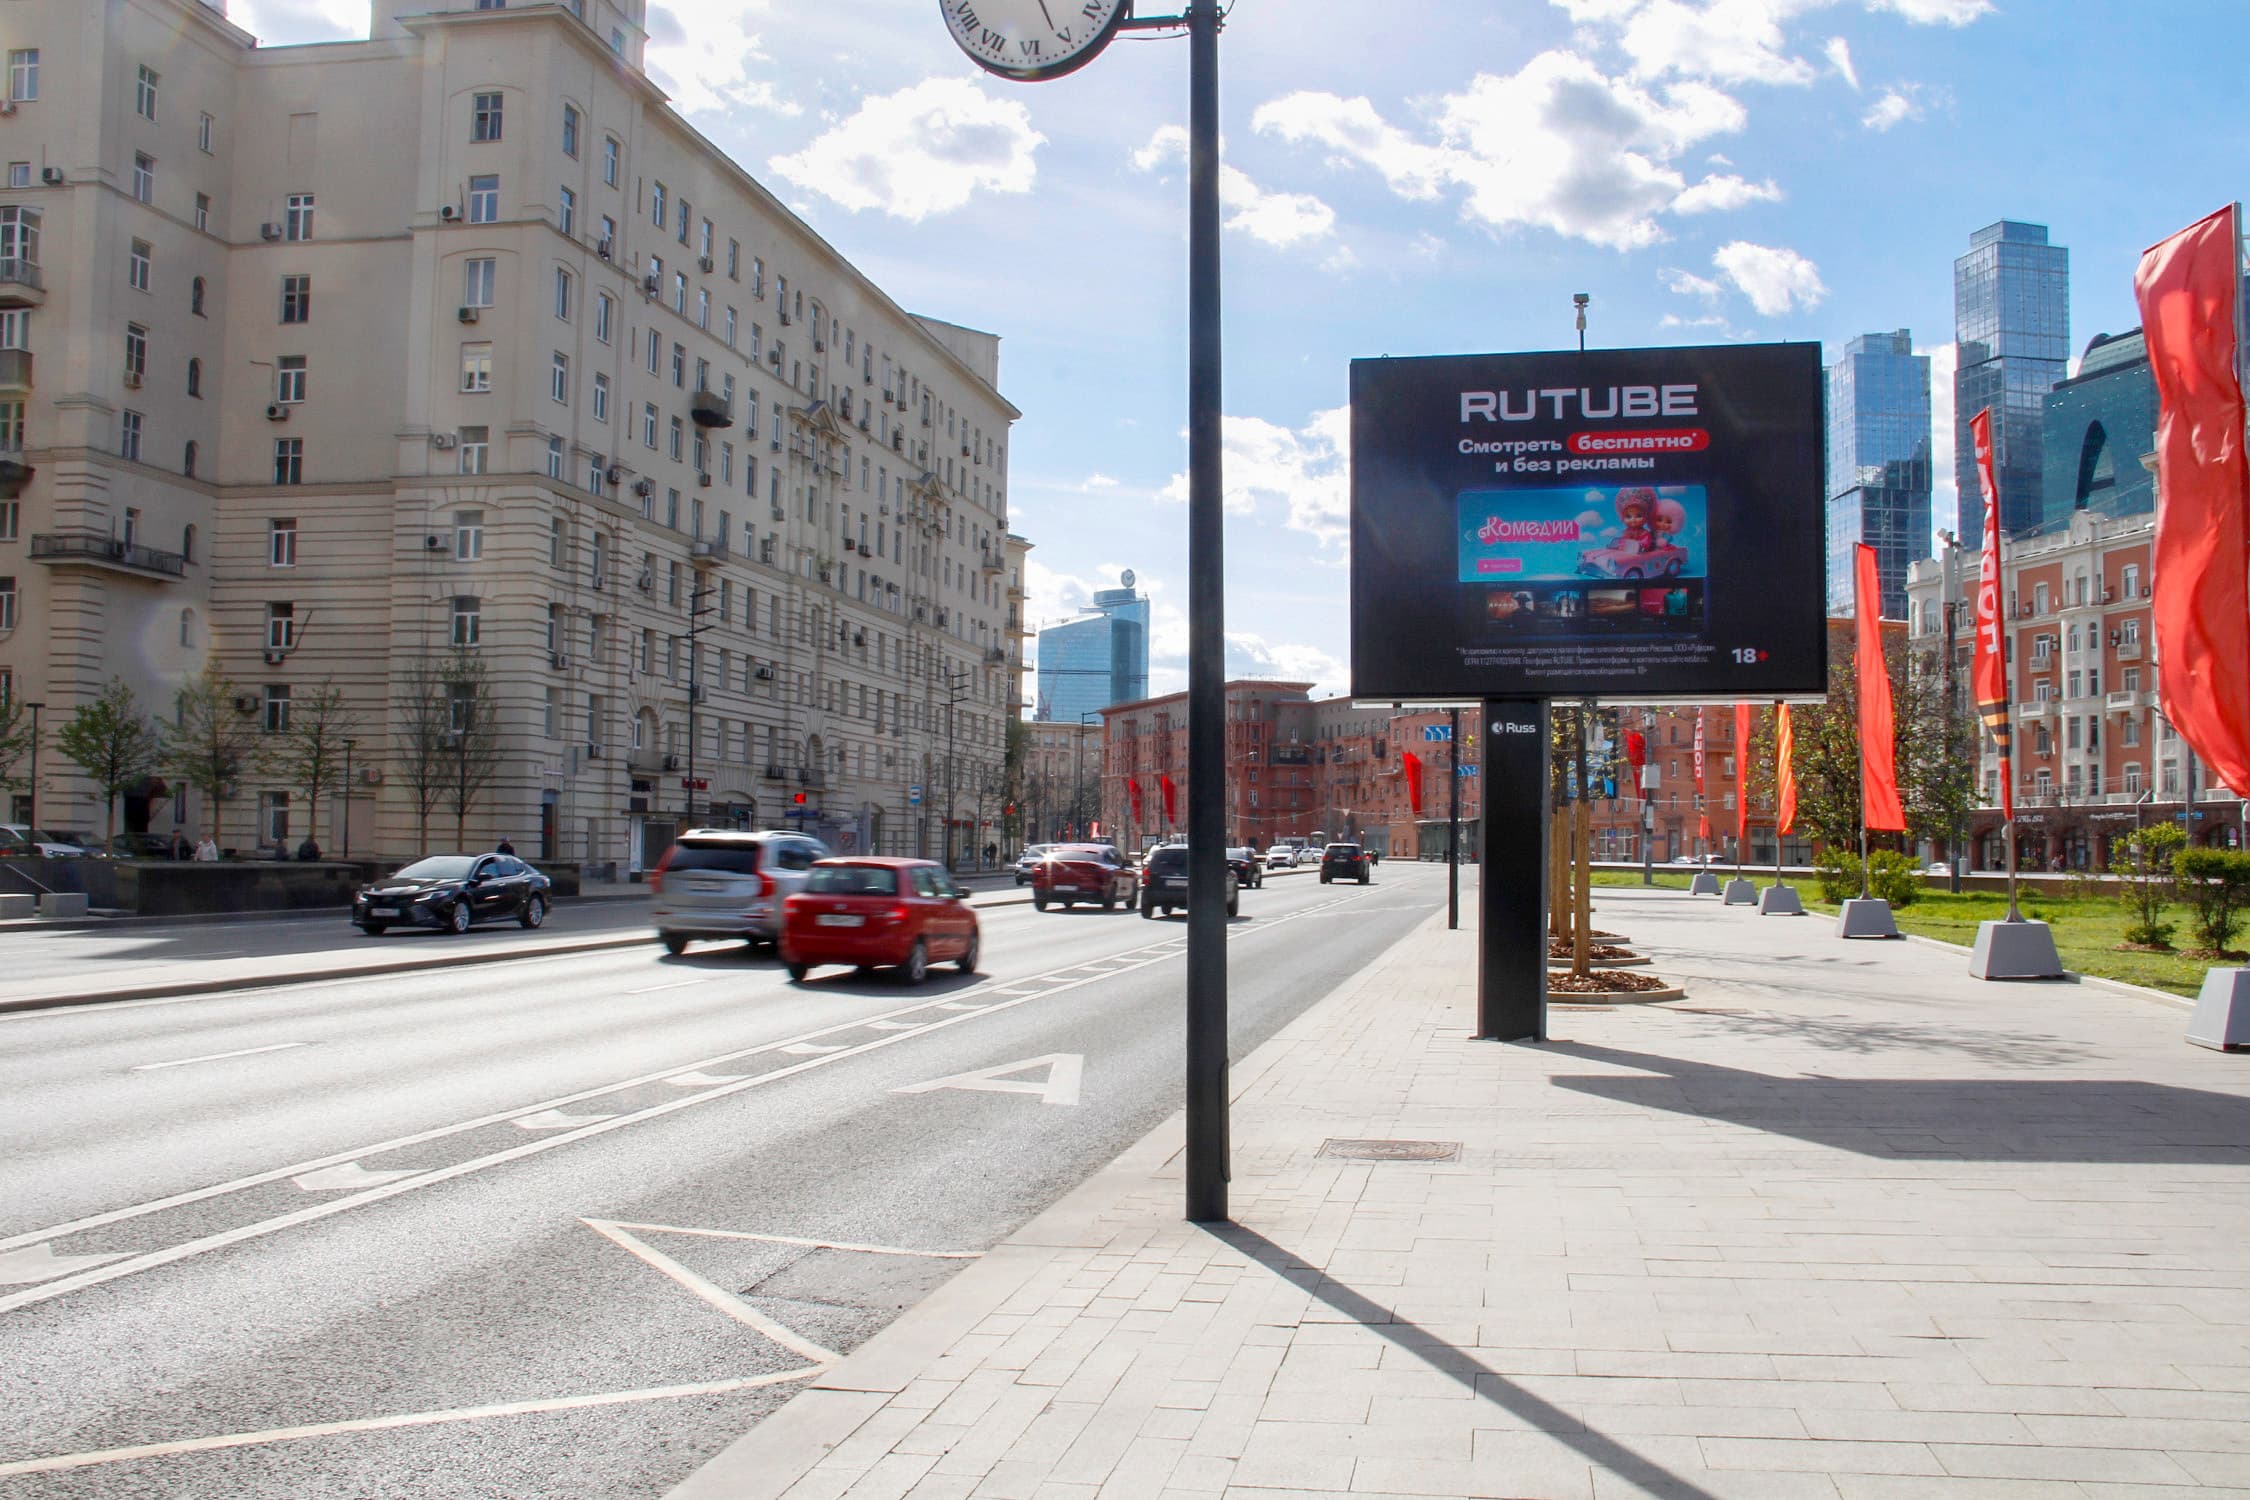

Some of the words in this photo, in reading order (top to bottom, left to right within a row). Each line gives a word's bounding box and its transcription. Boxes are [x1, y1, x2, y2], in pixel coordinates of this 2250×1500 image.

[981, 28, 1006, 53] VII
[1020, 40, 1040, 56] VI
[1459, 384, 1698, 423] RUTUBE
[1458, 439, 1562, 456] Смотреть
[1495, 462, 1508, 473] и
[1513, 457, 1552, 472] без
[1556, 457, 1655, 475] рекламы
[1478, 516, 1574, 538] Комедии
[1505, 721, 1536, 734] Russ
